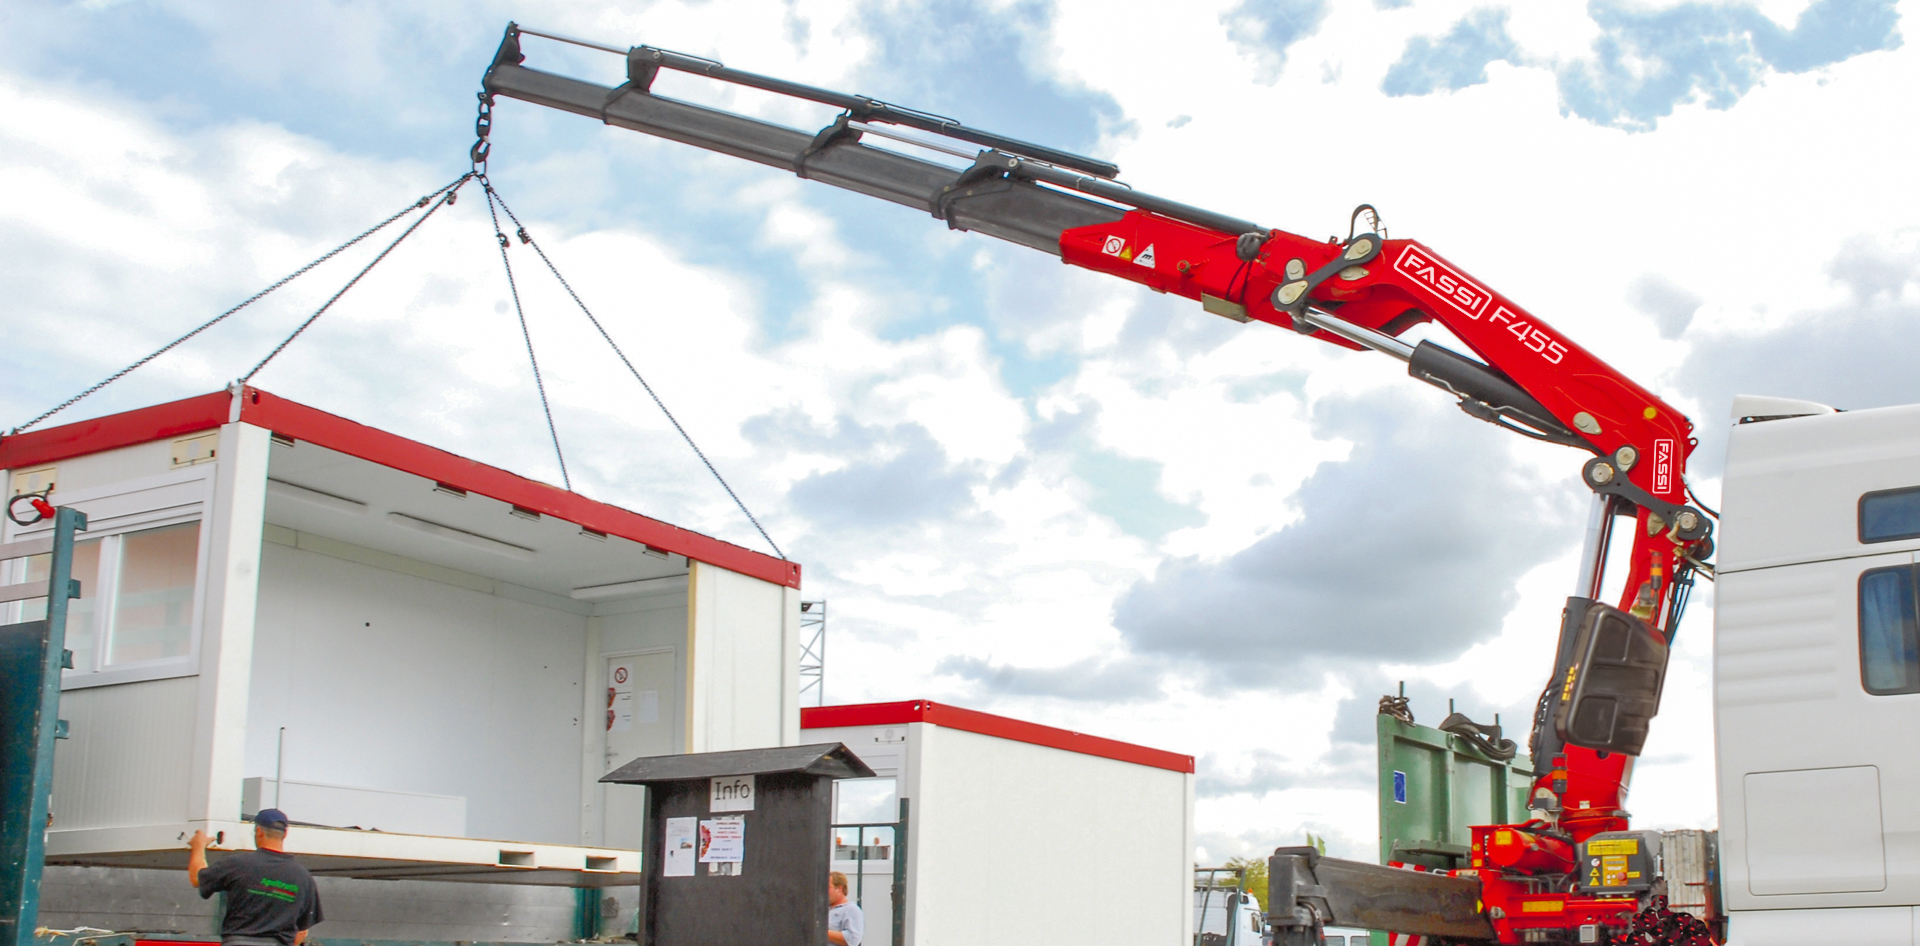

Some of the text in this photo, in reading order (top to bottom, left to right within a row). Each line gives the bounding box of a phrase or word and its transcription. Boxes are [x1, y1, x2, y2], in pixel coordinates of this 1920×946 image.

[1403, 253, 1569, 365] FASSI F455
[1657, 442, 1669, 490] FASSI
[715, 779, 750, 800] Info
